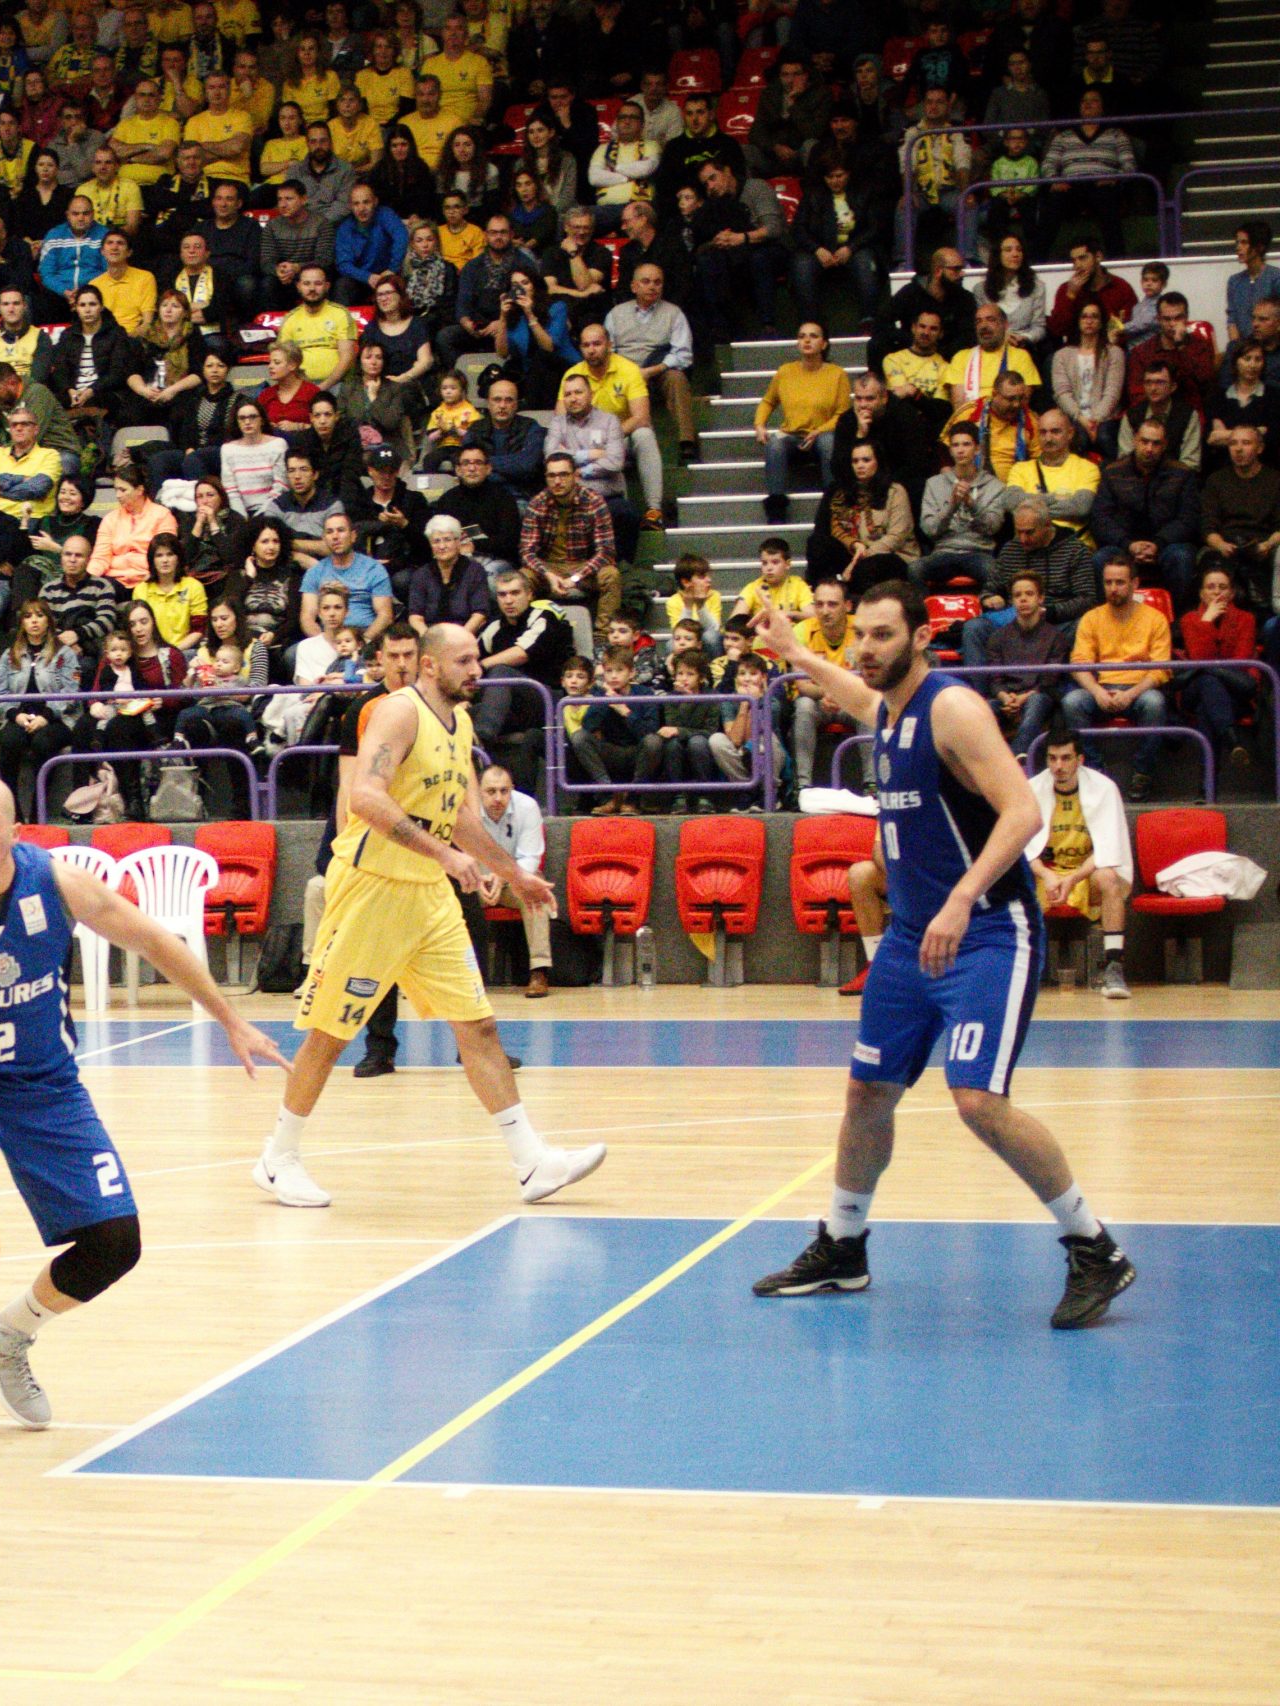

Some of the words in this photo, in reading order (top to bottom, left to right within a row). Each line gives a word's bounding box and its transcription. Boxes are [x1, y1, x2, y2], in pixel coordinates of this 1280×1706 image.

[337, 1003, 366, 1025] 14
[949, 1022, 984, 1061] 10
[93, 1152, 124, 1197] 2
